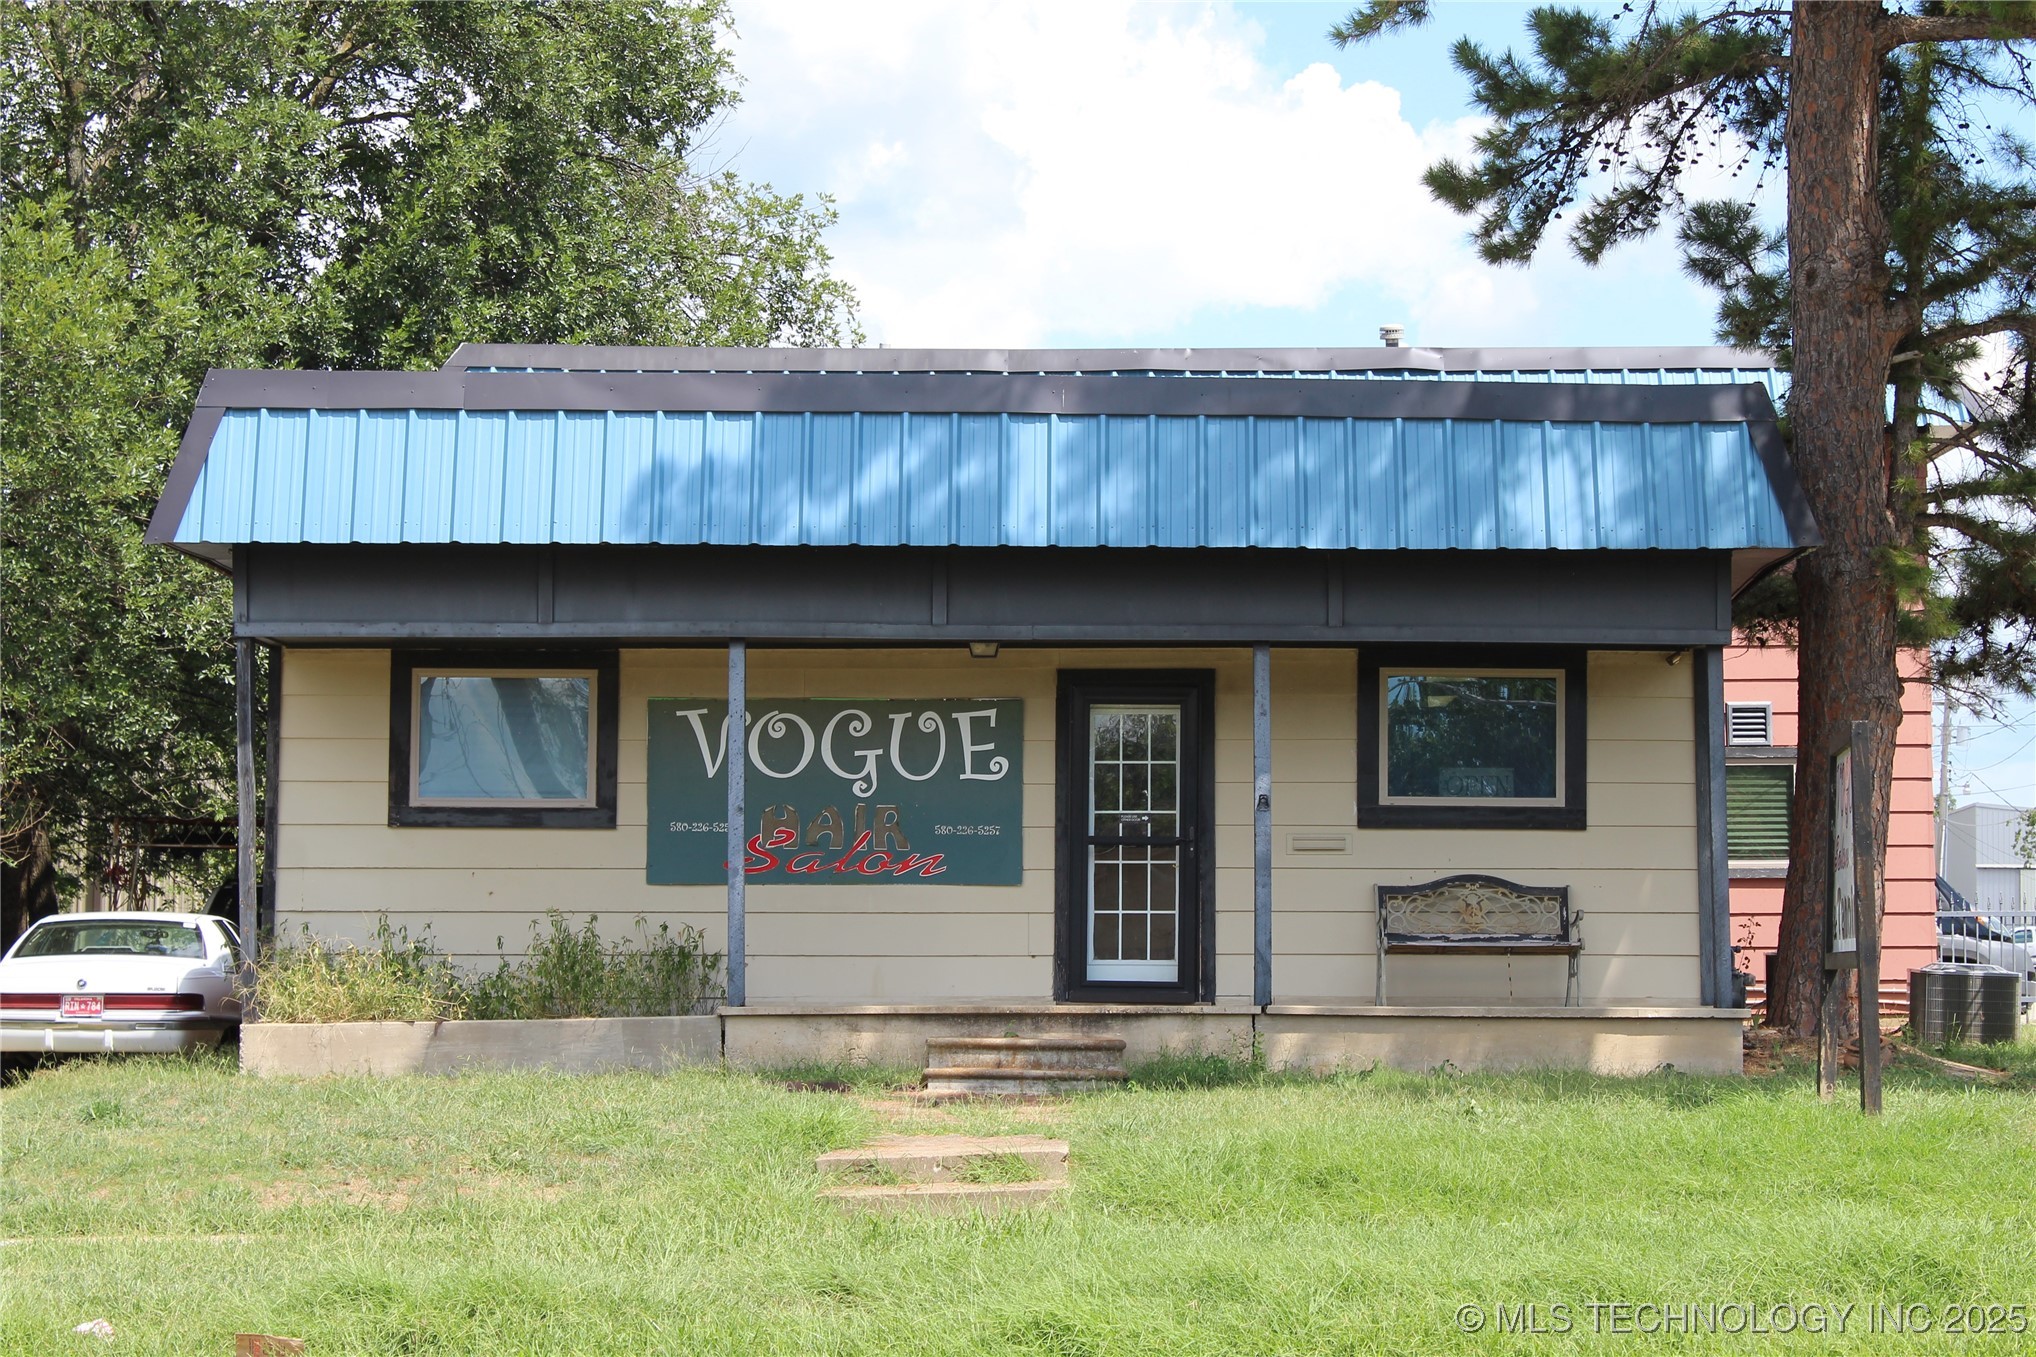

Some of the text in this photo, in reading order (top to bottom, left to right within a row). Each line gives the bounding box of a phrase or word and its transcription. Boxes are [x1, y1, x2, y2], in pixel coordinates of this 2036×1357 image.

[676, 708, 1009, 798] VOGUE
[1446, 775, 1510, 794] OPEN
[670, 822, 728, 833] 580-226-525
[760, 803, 911, 851] HAIR
[934, 824, 1001, 836] 580-226-5257
[723, 829, 947, 877] Salon
[86, 1001, 101, 1011] 784
